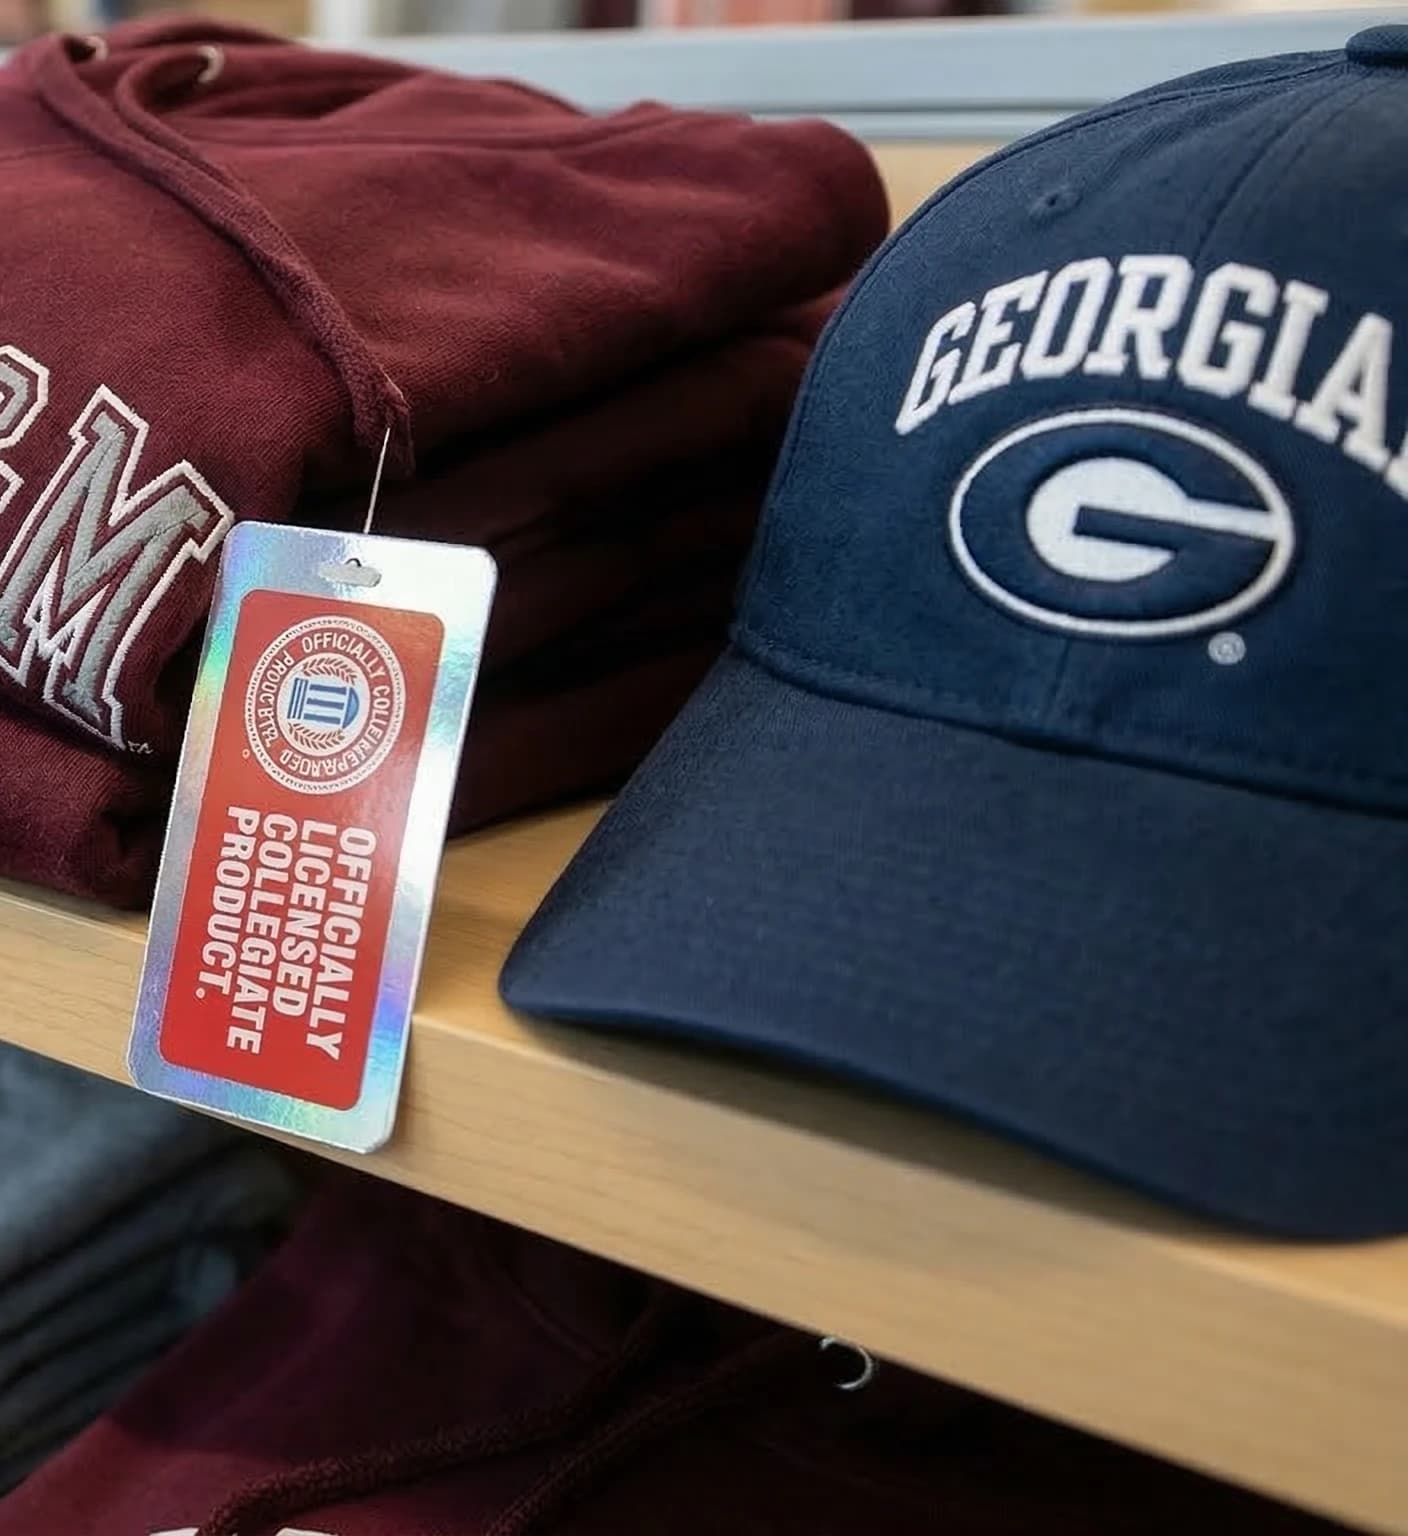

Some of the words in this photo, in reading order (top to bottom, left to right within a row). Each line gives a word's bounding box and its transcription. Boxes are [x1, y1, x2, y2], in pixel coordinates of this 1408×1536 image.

[894, 254, 1408, 503] GEORGIA
[301, 631, 386, 679] OFFICIALLY
[195, 805, 261, 999] PRODUCT.
[226, 812, 298, 1055] COLLEGIATE
[272, 819, 337, 1017] LICENSED
[306, 826, 377, 1061] OFFICIALLY
